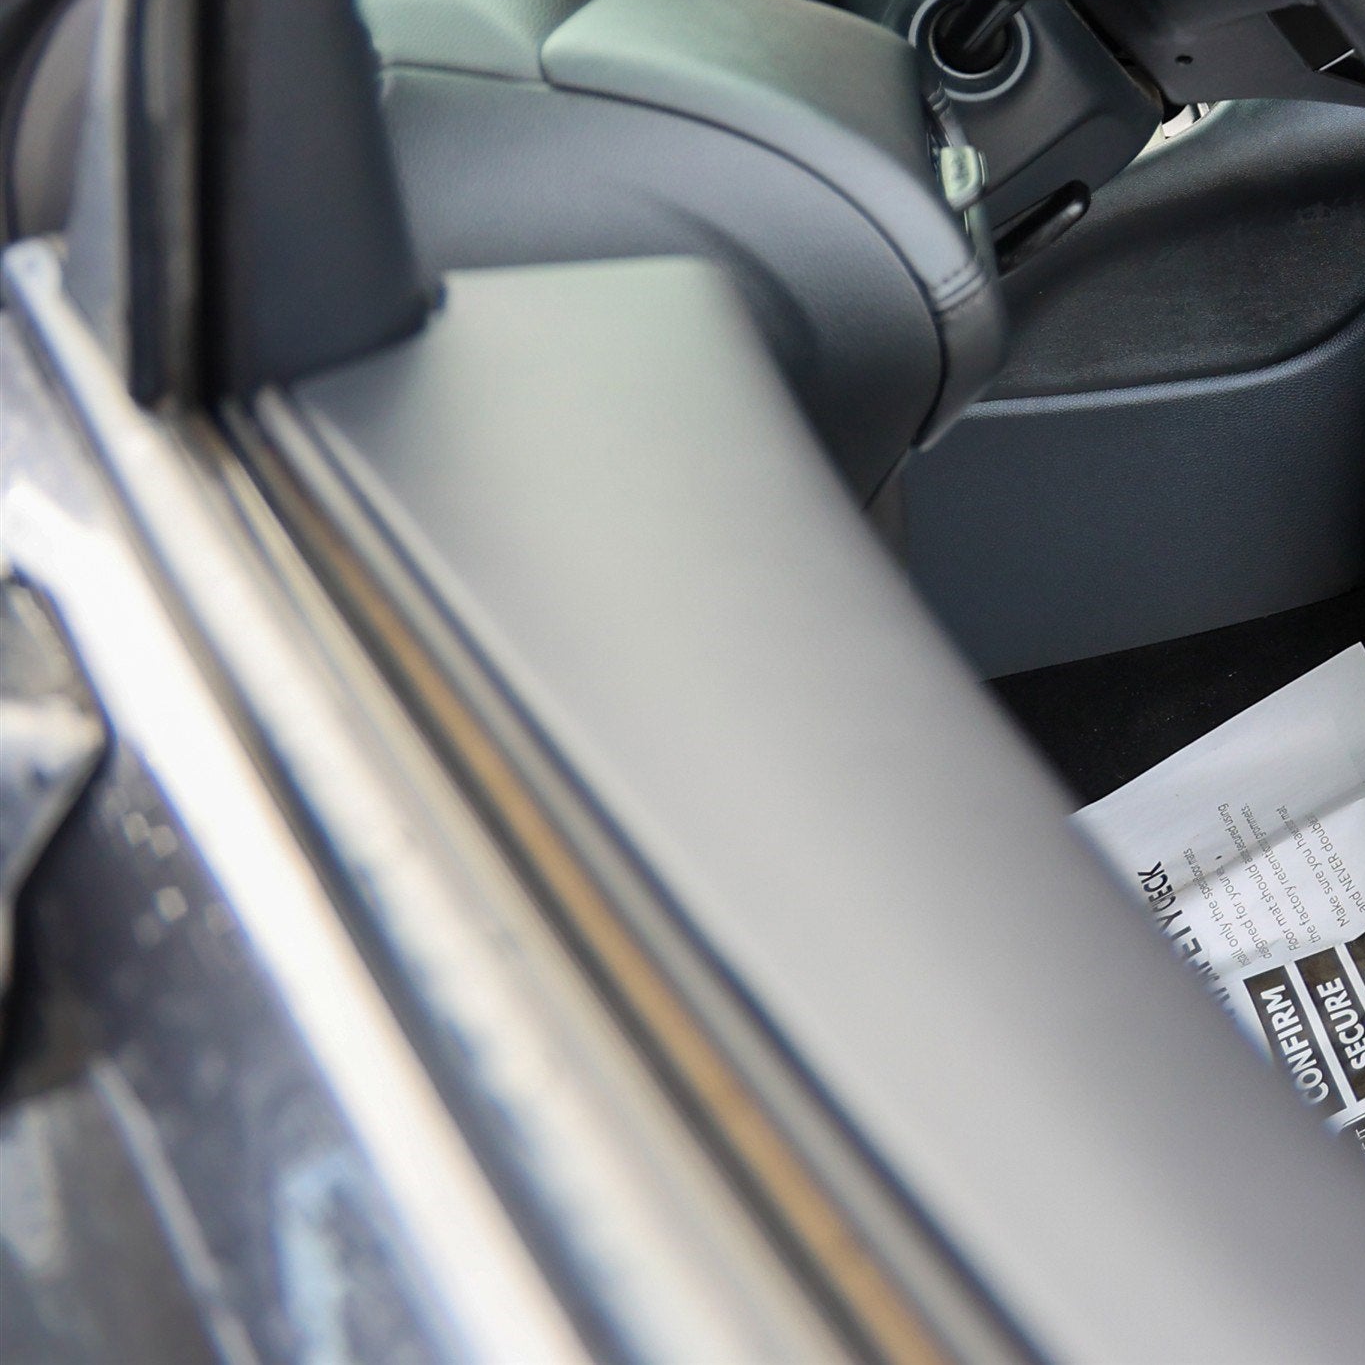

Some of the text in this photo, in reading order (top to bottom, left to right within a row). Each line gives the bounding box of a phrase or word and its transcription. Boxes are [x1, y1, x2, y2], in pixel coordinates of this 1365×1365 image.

[1217, 802, 1233, 826] using
[1301, 847, 1323, 871] you
[1327, 852, 1355, 892] NEVER
[1138, 862, 1175, 912] CECK
[1218, 875, 1241, 900] your
[1244, 863, 1274, 903] should
[1314, 869, 1333, 895] sure
[1207, 899, 1224, 922] the
[1232, 901, 1248, 920] for
[1267, 901, 1287, 927] mat
[1284, 885, 1310, 926] factory
[1328, 895, 1350, 927] Make
[1218, 921, 1238, 948] only
[1306, 924, 1321, 944] the
[1261, 986, 1327, 1100] CONFIRM
